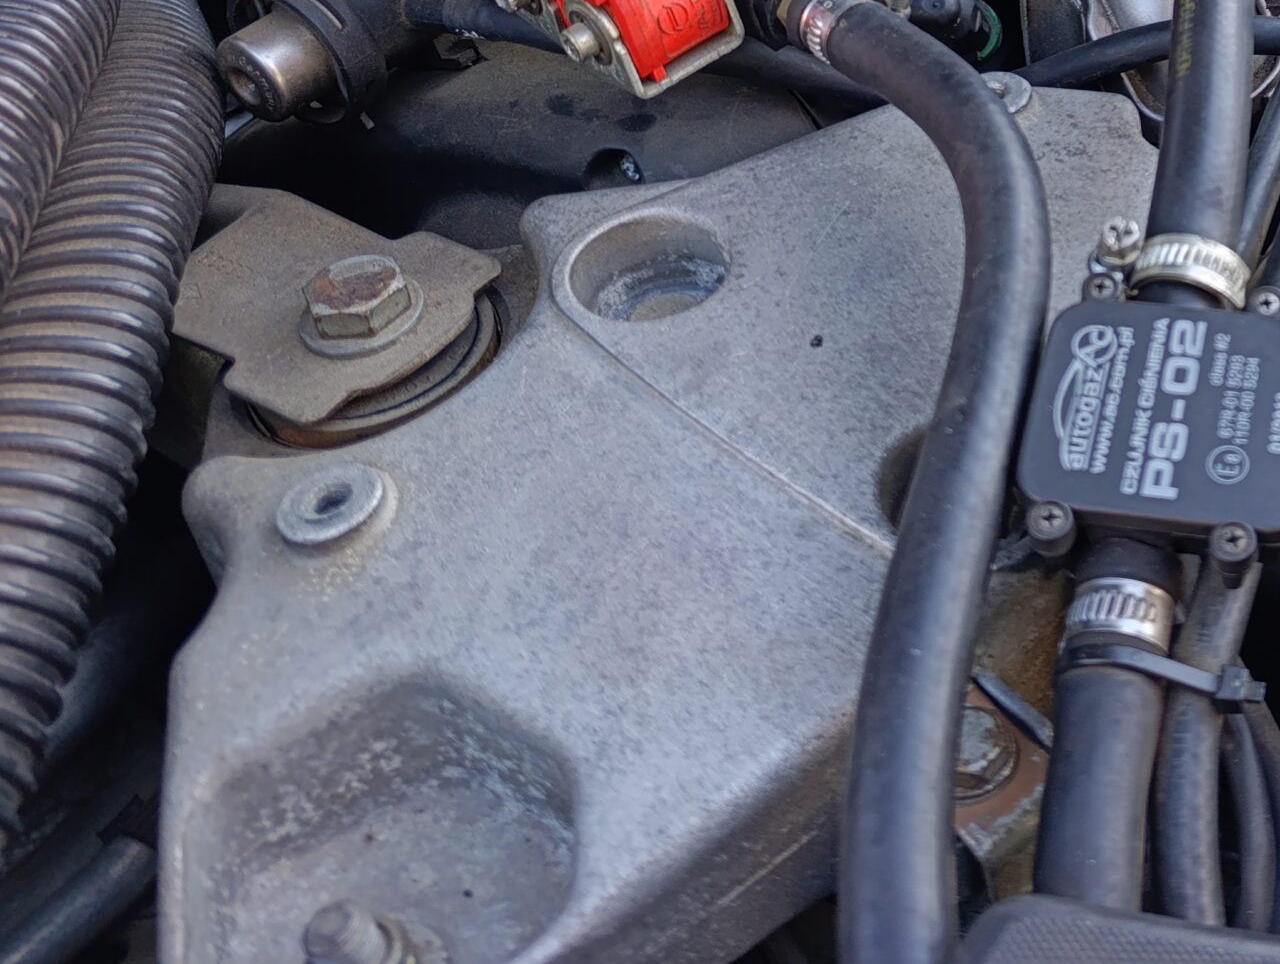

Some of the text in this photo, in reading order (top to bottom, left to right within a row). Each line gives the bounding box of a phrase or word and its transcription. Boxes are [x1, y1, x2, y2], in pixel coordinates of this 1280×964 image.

[1069, 365, 1105, 471] autogaz
[1089, 326, 1136, 474] www.ac.com.pl
[1119, 317, 1171, 495] CZUJNIK CIŚNIENIA
[1138, 319, 1209, 501] PS-02
